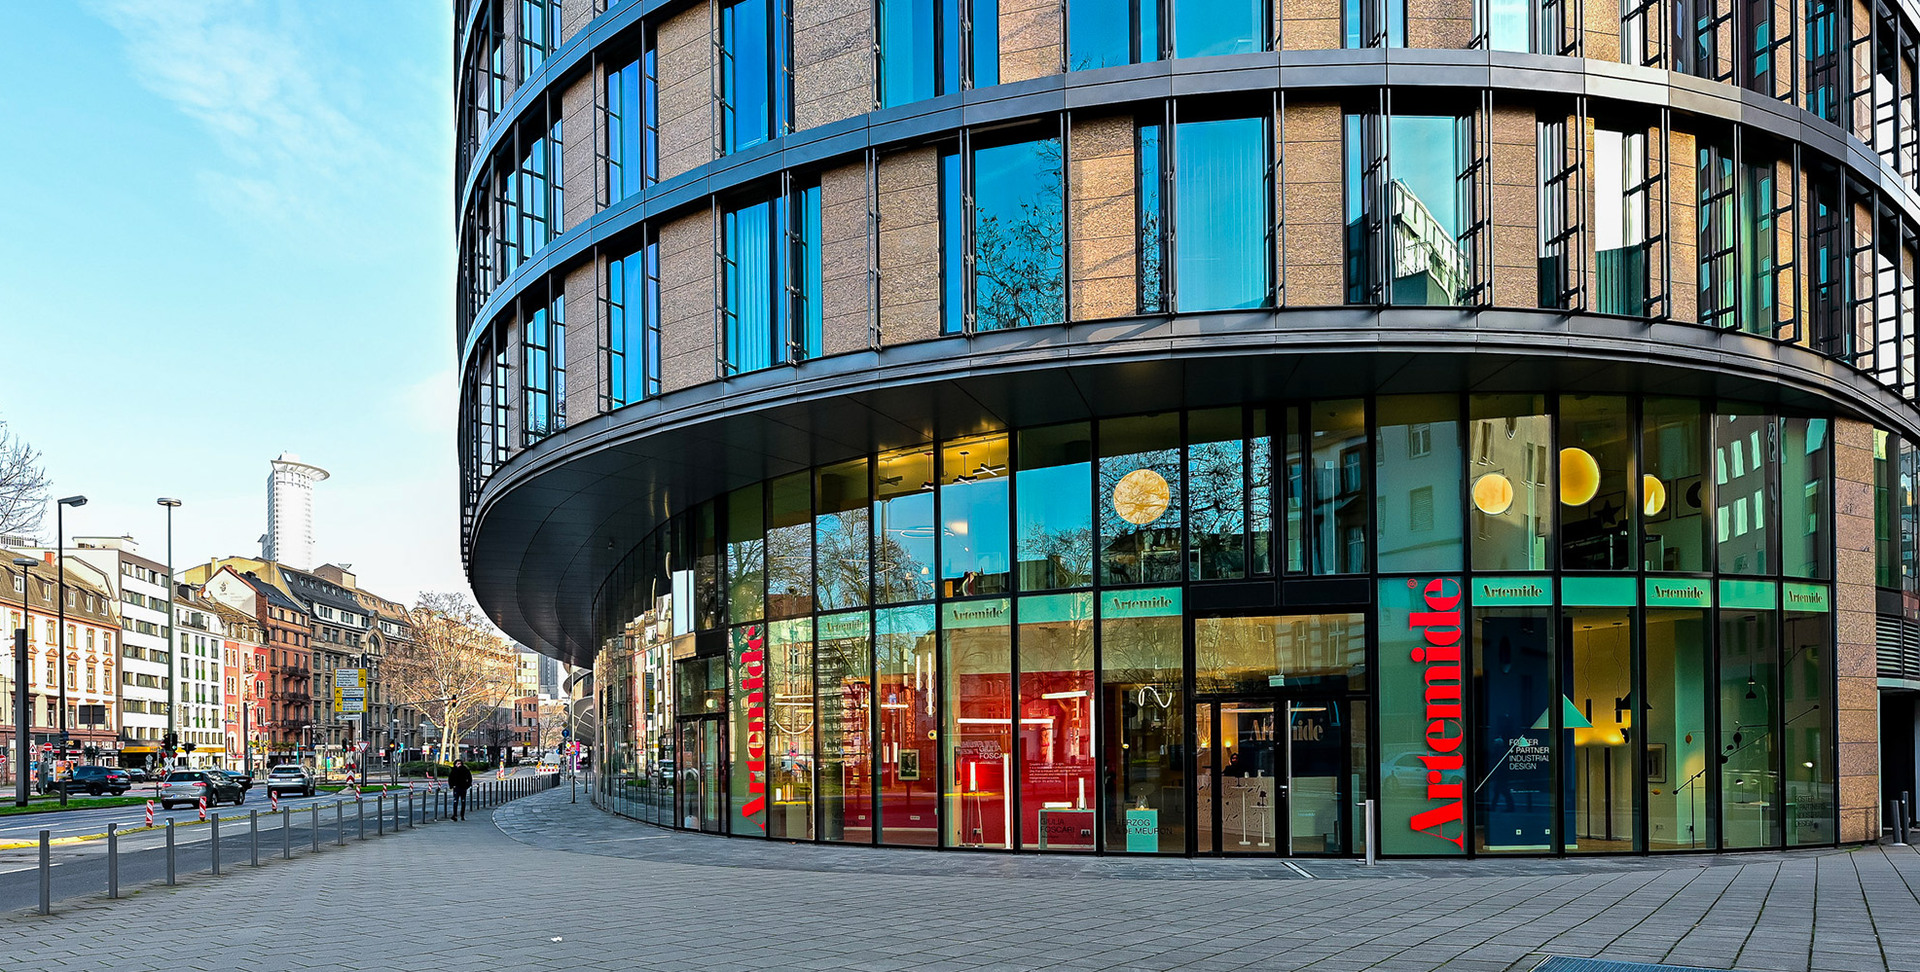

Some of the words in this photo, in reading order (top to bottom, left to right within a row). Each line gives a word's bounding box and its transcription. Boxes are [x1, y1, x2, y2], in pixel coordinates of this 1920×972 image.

[1480, 585, 1543, 598] Artemide
[1651, 585, 1704, 599] Artemide
[1787, 590, 1823, 603] Artemide
[1110, 596, 1173, 610] Artemide
[950, 607, 1003, 621] Artemide
[1410, 578, 1464, 852] Artemide
[741, 625, 766, 832] Artemide
[1509, 762, 1537, 770] DESIGN
